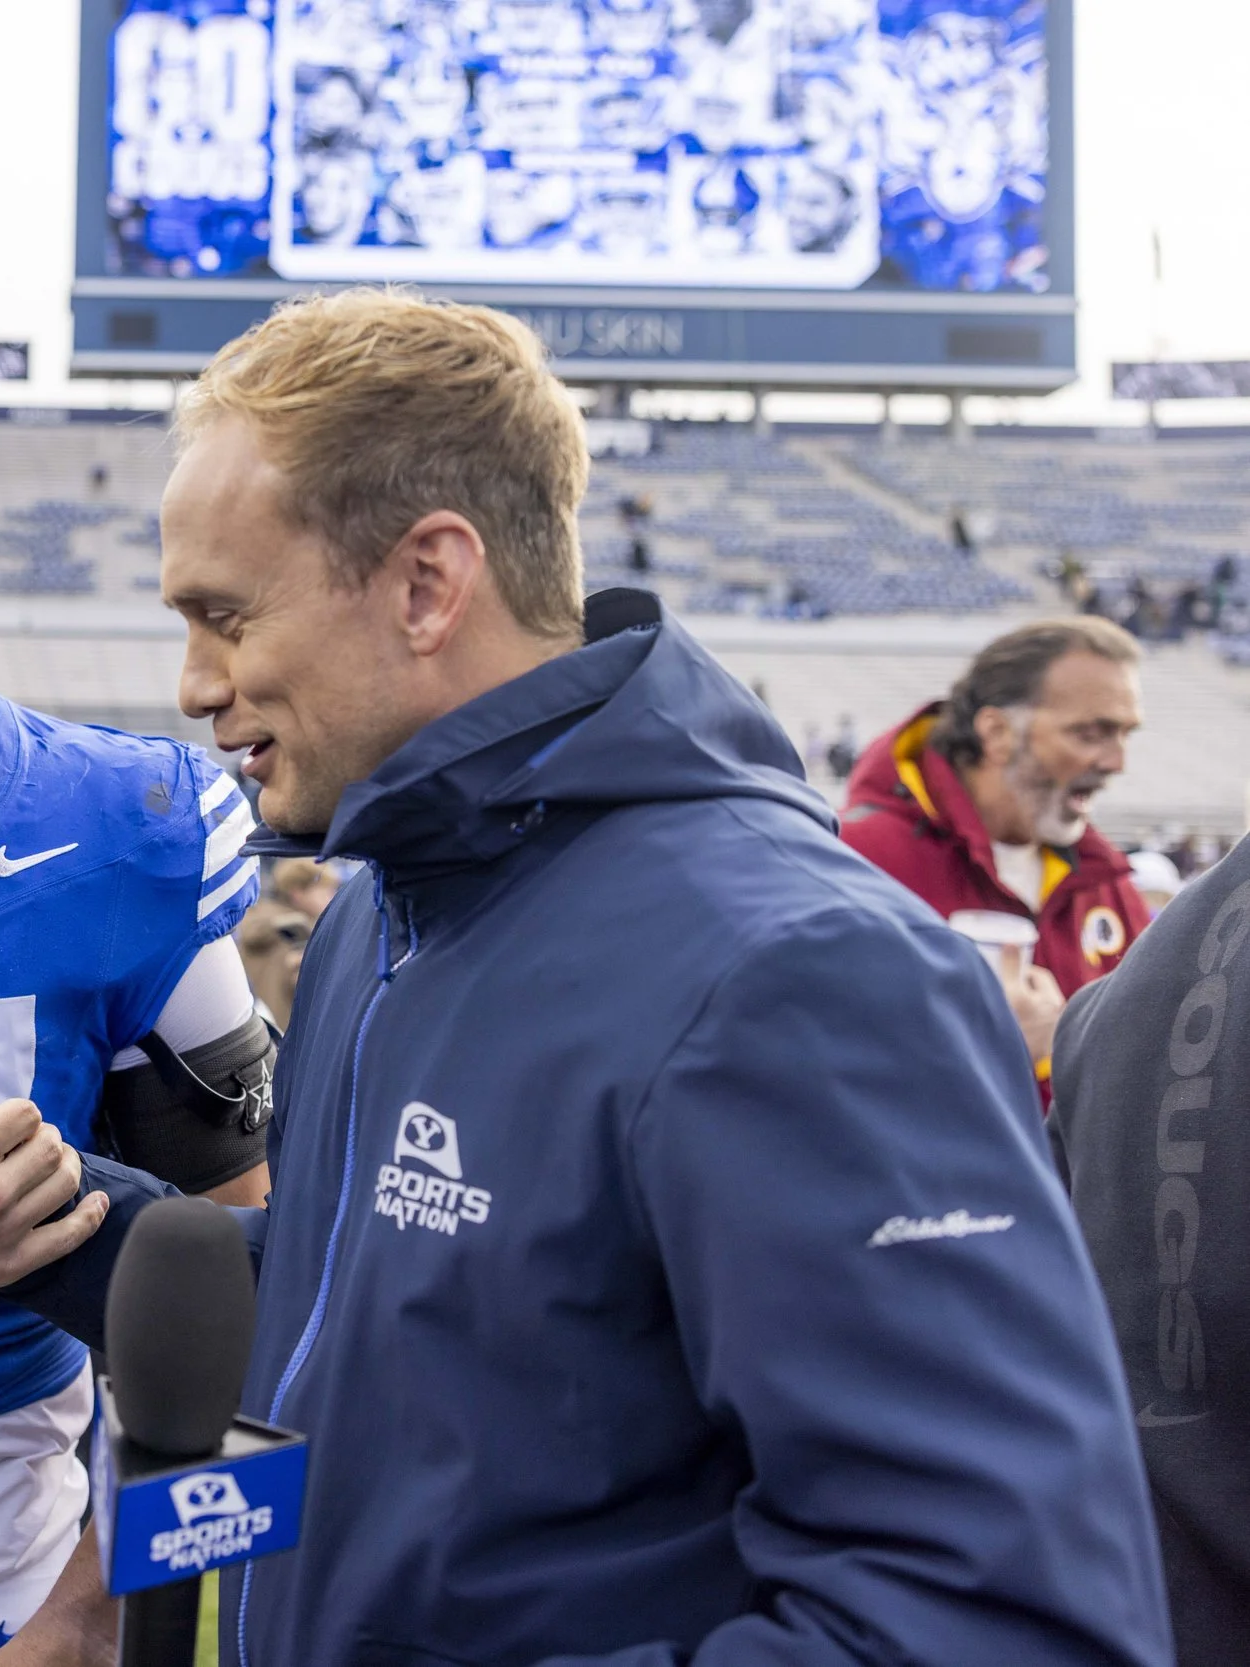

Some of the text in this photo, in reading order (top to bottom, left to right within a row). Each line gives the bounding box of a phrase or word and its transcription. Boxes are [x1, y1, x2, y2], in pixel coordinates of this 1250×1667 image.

[584, 310, 684, 356] SKIN
[410, 1116, 442, 1149] Y
[374, 1164, 492, 1224] PORTS
[374, 1191, 460, 1236] NATION
[150, 1506, 273, 1562] SPORTS
[169, 1535, 253, 1570] NATION
